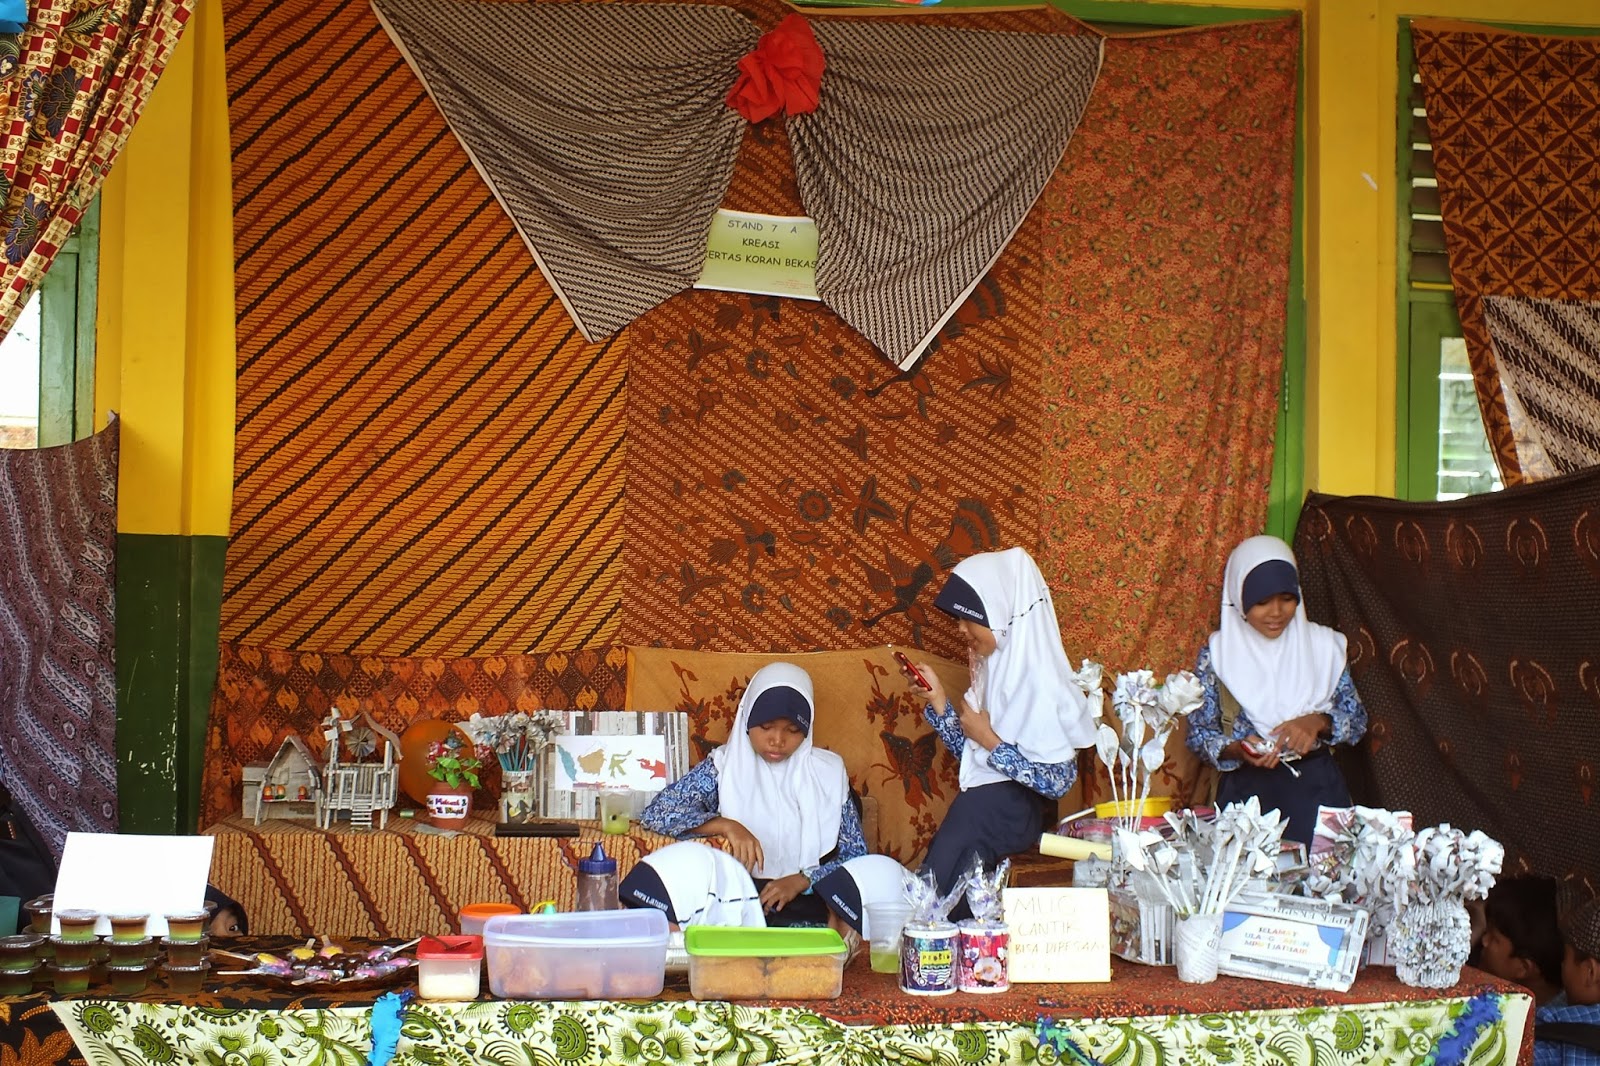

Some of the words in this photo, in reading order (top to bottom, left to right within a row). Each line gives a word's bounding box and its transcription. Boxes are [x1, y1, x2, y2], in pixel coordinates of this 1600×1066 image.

[727, 219, 763, 232] STAND
[771, 224, 778, 233] 7
[790, 226, 797, 234] A
[742, 238, 780, 250] KREASI
[745, 254, 781, 266] KORAN
[785, 258, 817, 269] BEKAS
[1244, 932, 1276, 942] ULAG
